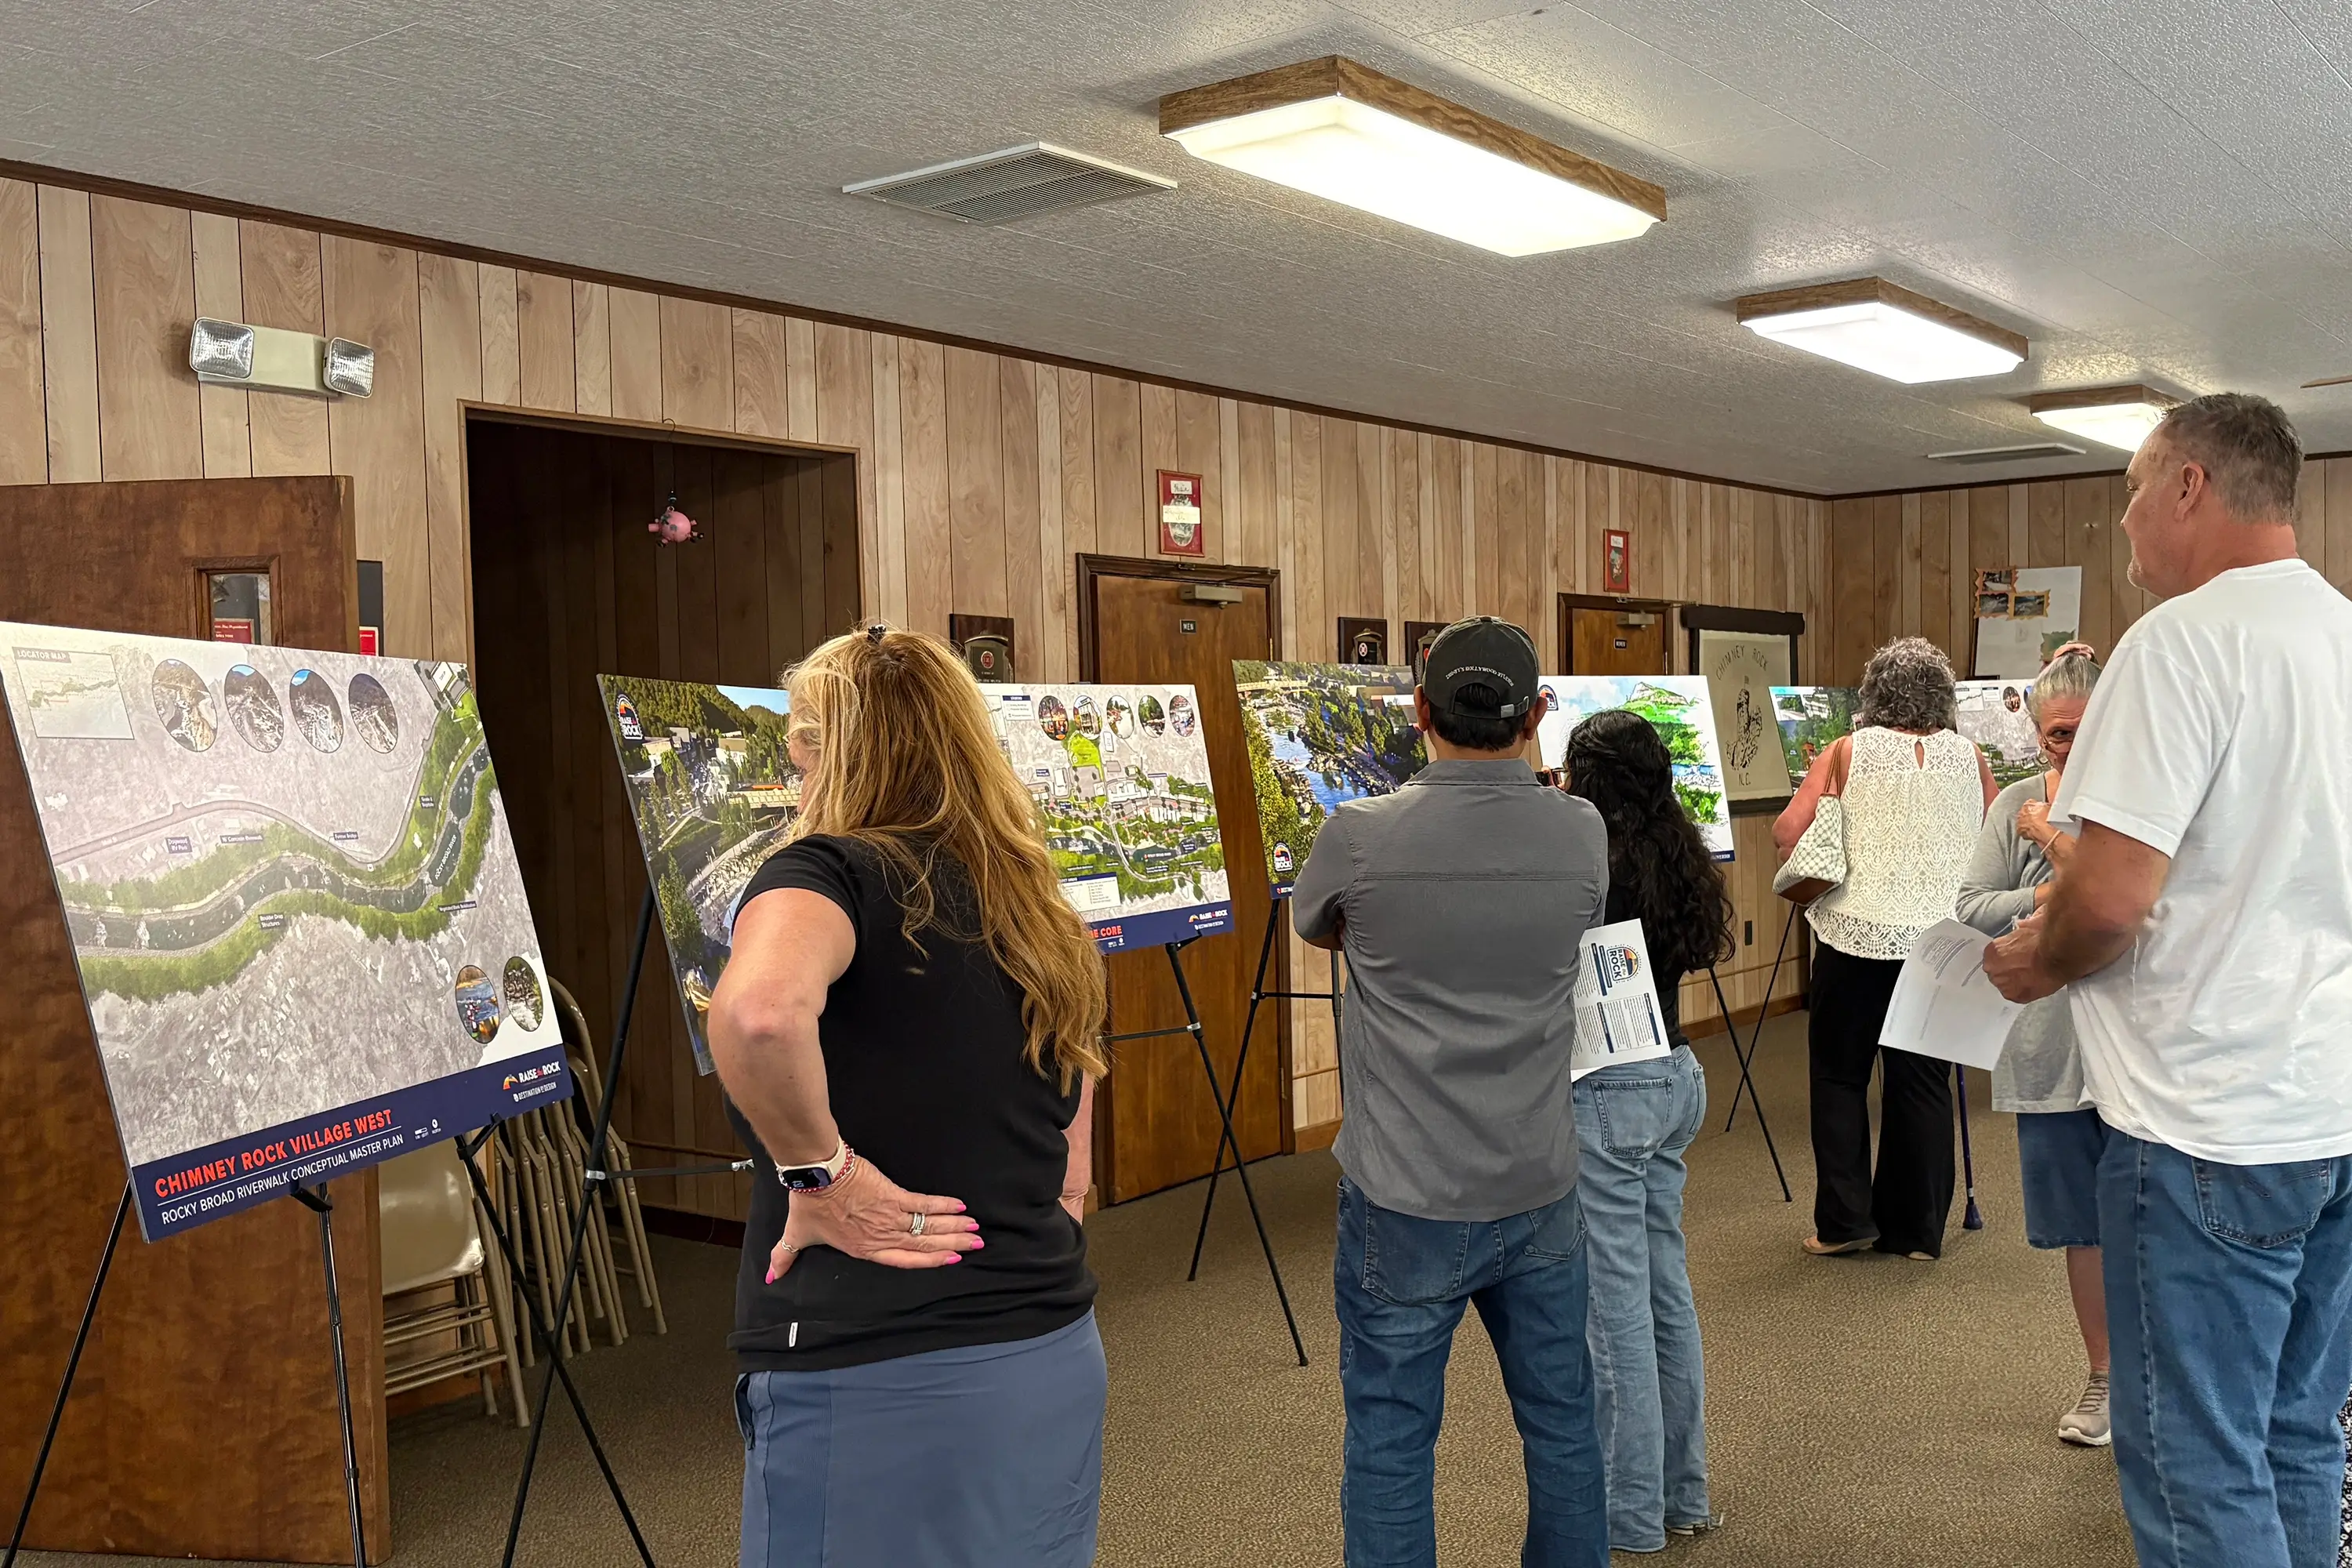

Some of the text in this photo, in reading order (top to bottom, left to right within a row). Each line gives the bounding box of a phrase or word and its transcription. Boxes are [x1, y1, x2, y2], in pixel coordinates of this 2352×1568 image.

[16, 650, 50, 659] LOCATOR
[1715, 644, 1768, 681] CHIMNEY ROCK
[1101, 925, 1123, 937] CORE
[1609, 950, 1622, 979] ROCK
[1617, 949, 1626, 967] RAISE
[518, 1068, 539, 1083] RAISE
[542, 1061, 561, 1075] ROCK
[518, 1086, 541, 1100] DESTINATION
[154, 1109, 392, 1198] CHIMNEY ROCK VILLAGE WEST
[162, 1134, 404, 1225] ROCKY BROAD RIVERWALK CONCEPTUAL MASTER PLAN
